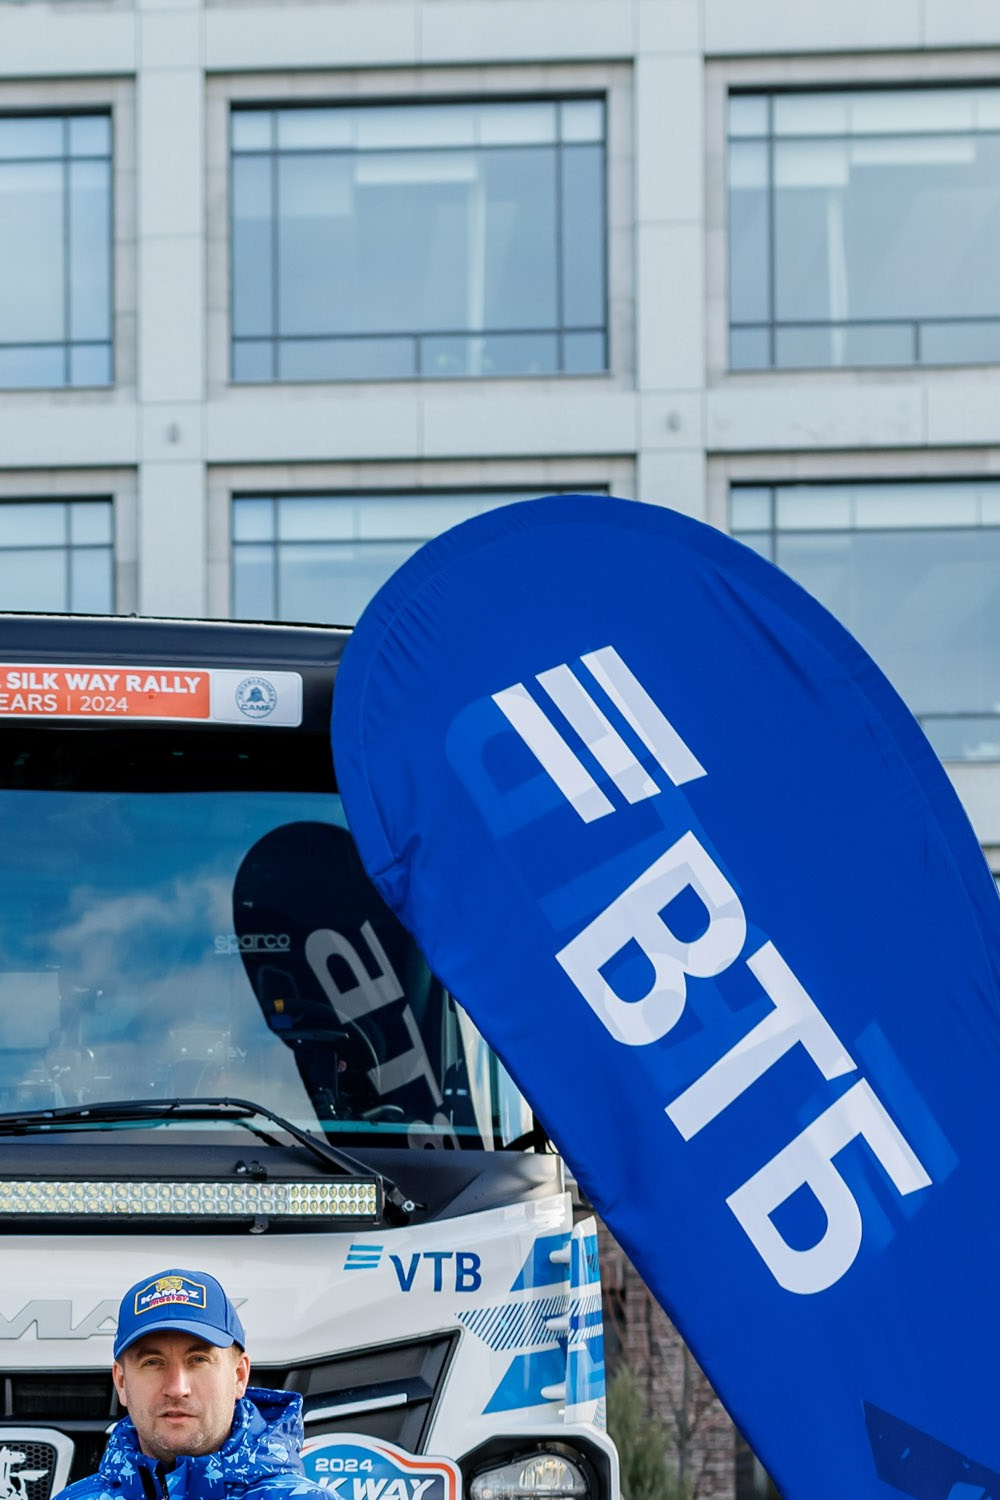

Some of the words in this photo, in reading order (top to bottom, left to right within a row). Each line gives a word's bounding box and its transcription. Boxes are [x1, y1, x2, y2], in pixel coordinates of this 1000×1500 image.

[6, 672, 60, 692] SILK
[66, 673, 120, 693] WAY
[126, 674, 201, 695] RALLY
[79, 696, 129, 713] 2024
[214, 932, 291, 952] sparco
[555, 829, 932, 1296] ВТБ
[388, 1251, 483, 1293] VTB
[140, 1288, 200, 1305] KAMAZ
[149, 1294, 190, 1307] master
[314, 1457, 373, 1473] 2024
